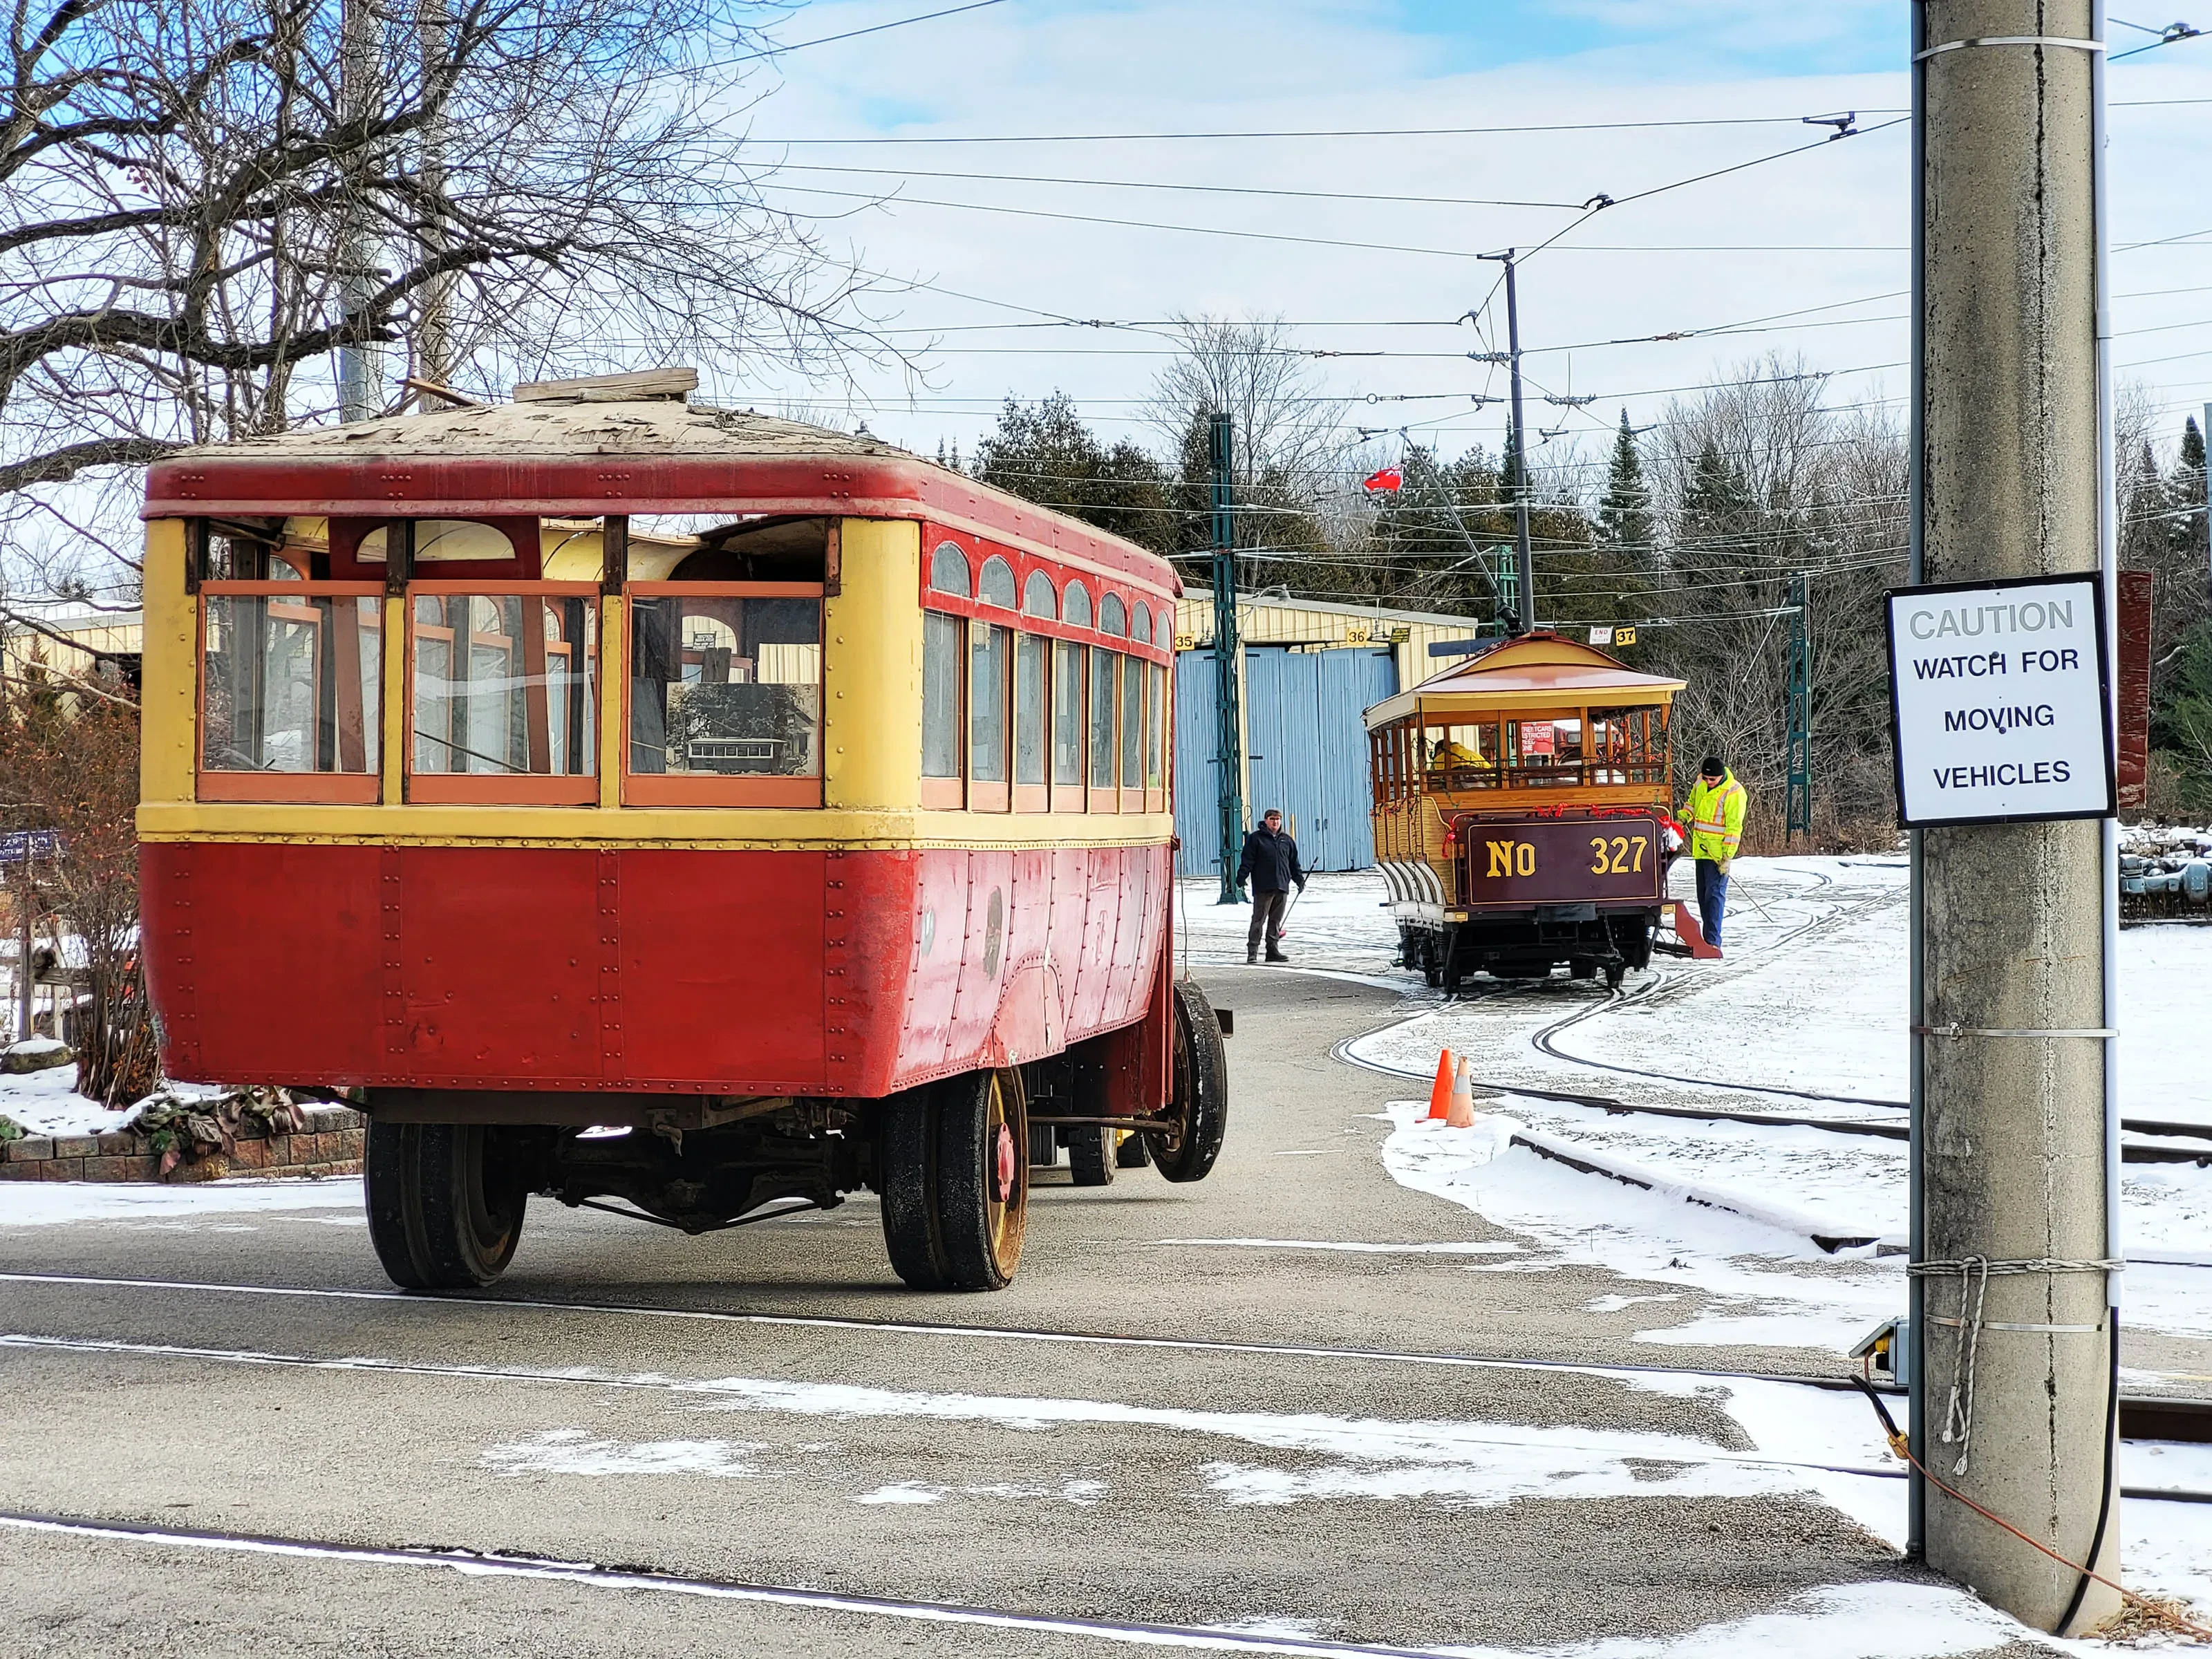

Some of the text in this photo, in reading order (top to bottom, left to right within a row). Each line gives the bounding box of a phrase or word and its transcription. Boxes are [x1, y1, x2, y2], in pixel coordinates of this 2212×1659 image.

[1909, 600, 2073, 640] CAUTION
[1175, 636, 1192, 647] 35
[1349, 631, 1365, 643] 36
[1618, 630, 1633, 641] 37
[1913, 648, 2079, 679] WATCH FOR
[1944, 704, 2054, 731] MOVING
[1933, 760, 2071, 789] VEHICLES
[1485, 836, 1648, 877] NO 327
